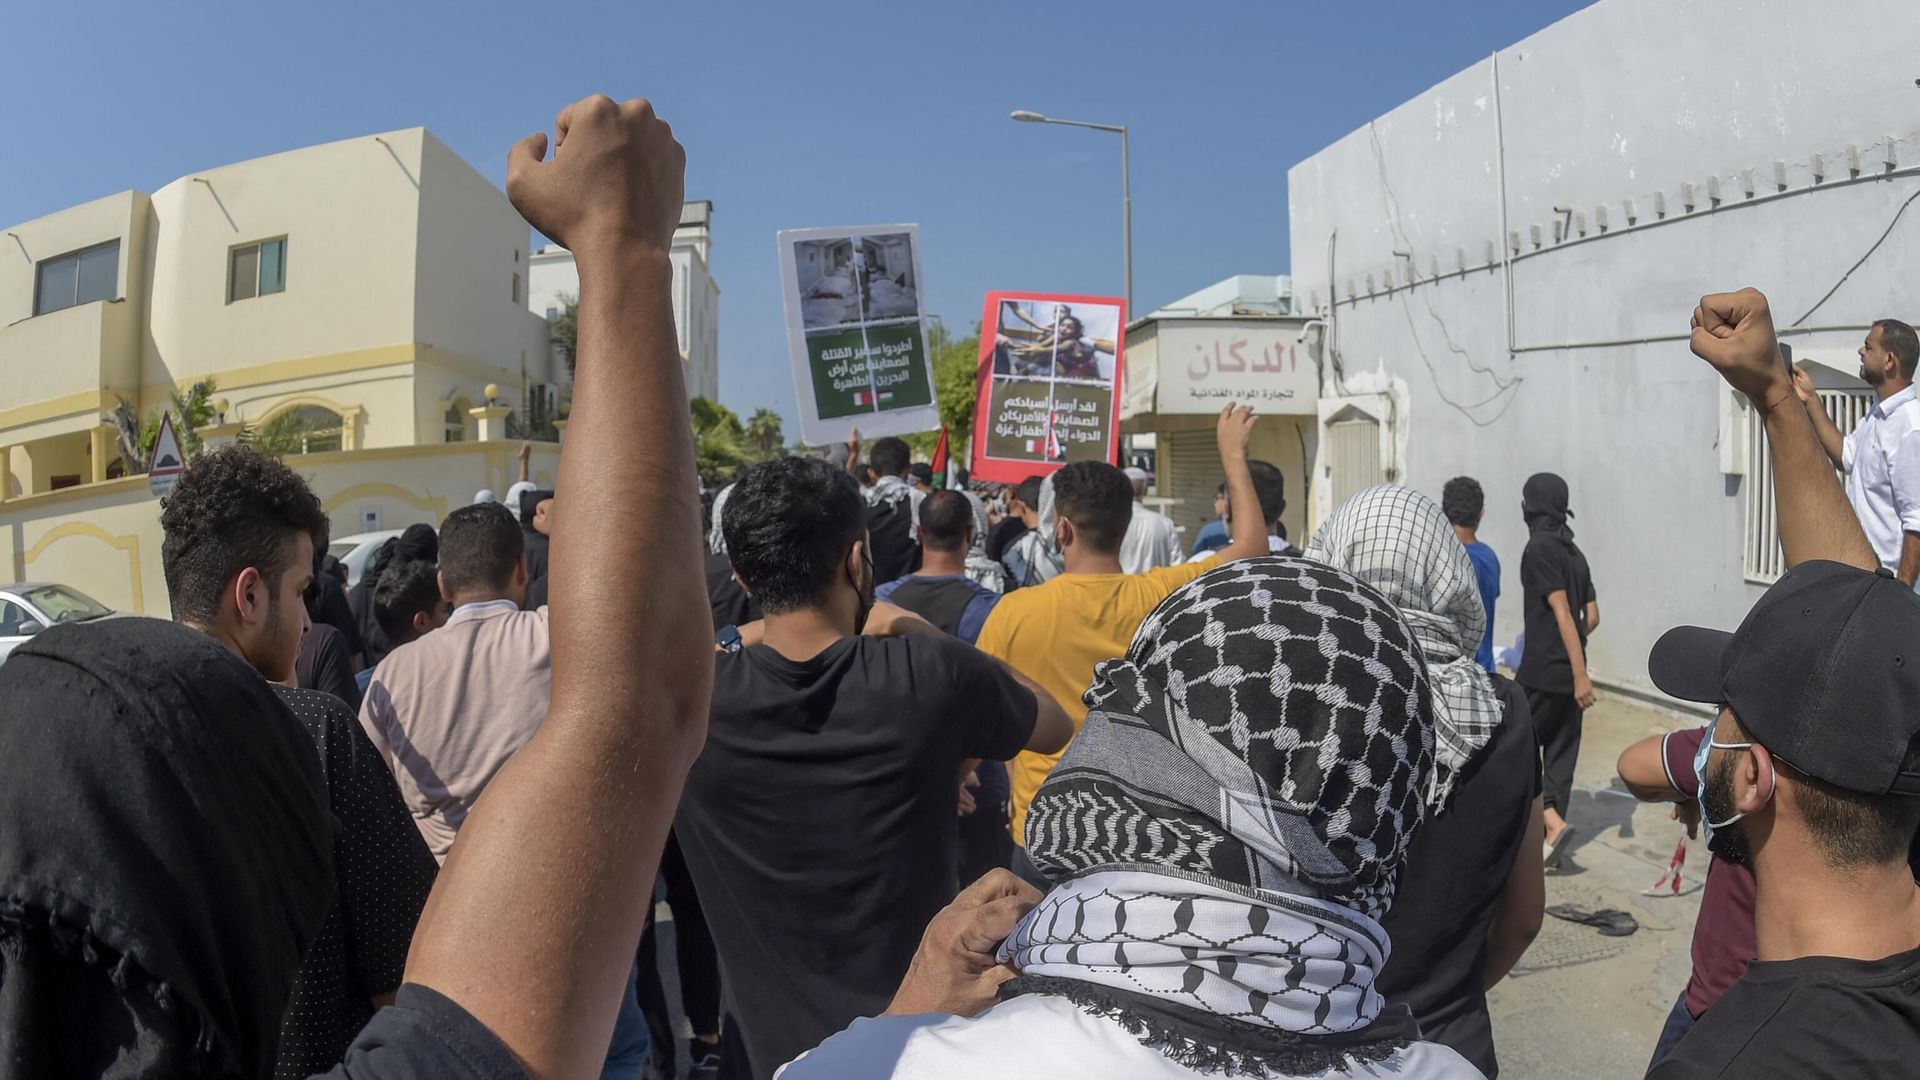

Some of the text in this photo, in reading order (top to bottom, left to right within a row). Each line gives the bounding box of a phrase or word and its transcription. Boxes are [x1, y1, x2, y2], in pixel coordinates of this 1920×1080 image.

[821, 346, 852, 361] القتلة
[853, 345, 881, 359] سير
[828, 359, 848, 378] أرض
[849, 362, 865, 375] من
[833, 370, 910, 392] البحرين لطاهرة
[1236, 388, 1259, 400] المواد
[1262, 388, 1294, 401] لتجارة
[1078, 402, 1097, 413] لقد
[995, 421, 1014, 437] غزة
[1070, 429, 1101, 443] الدواء
